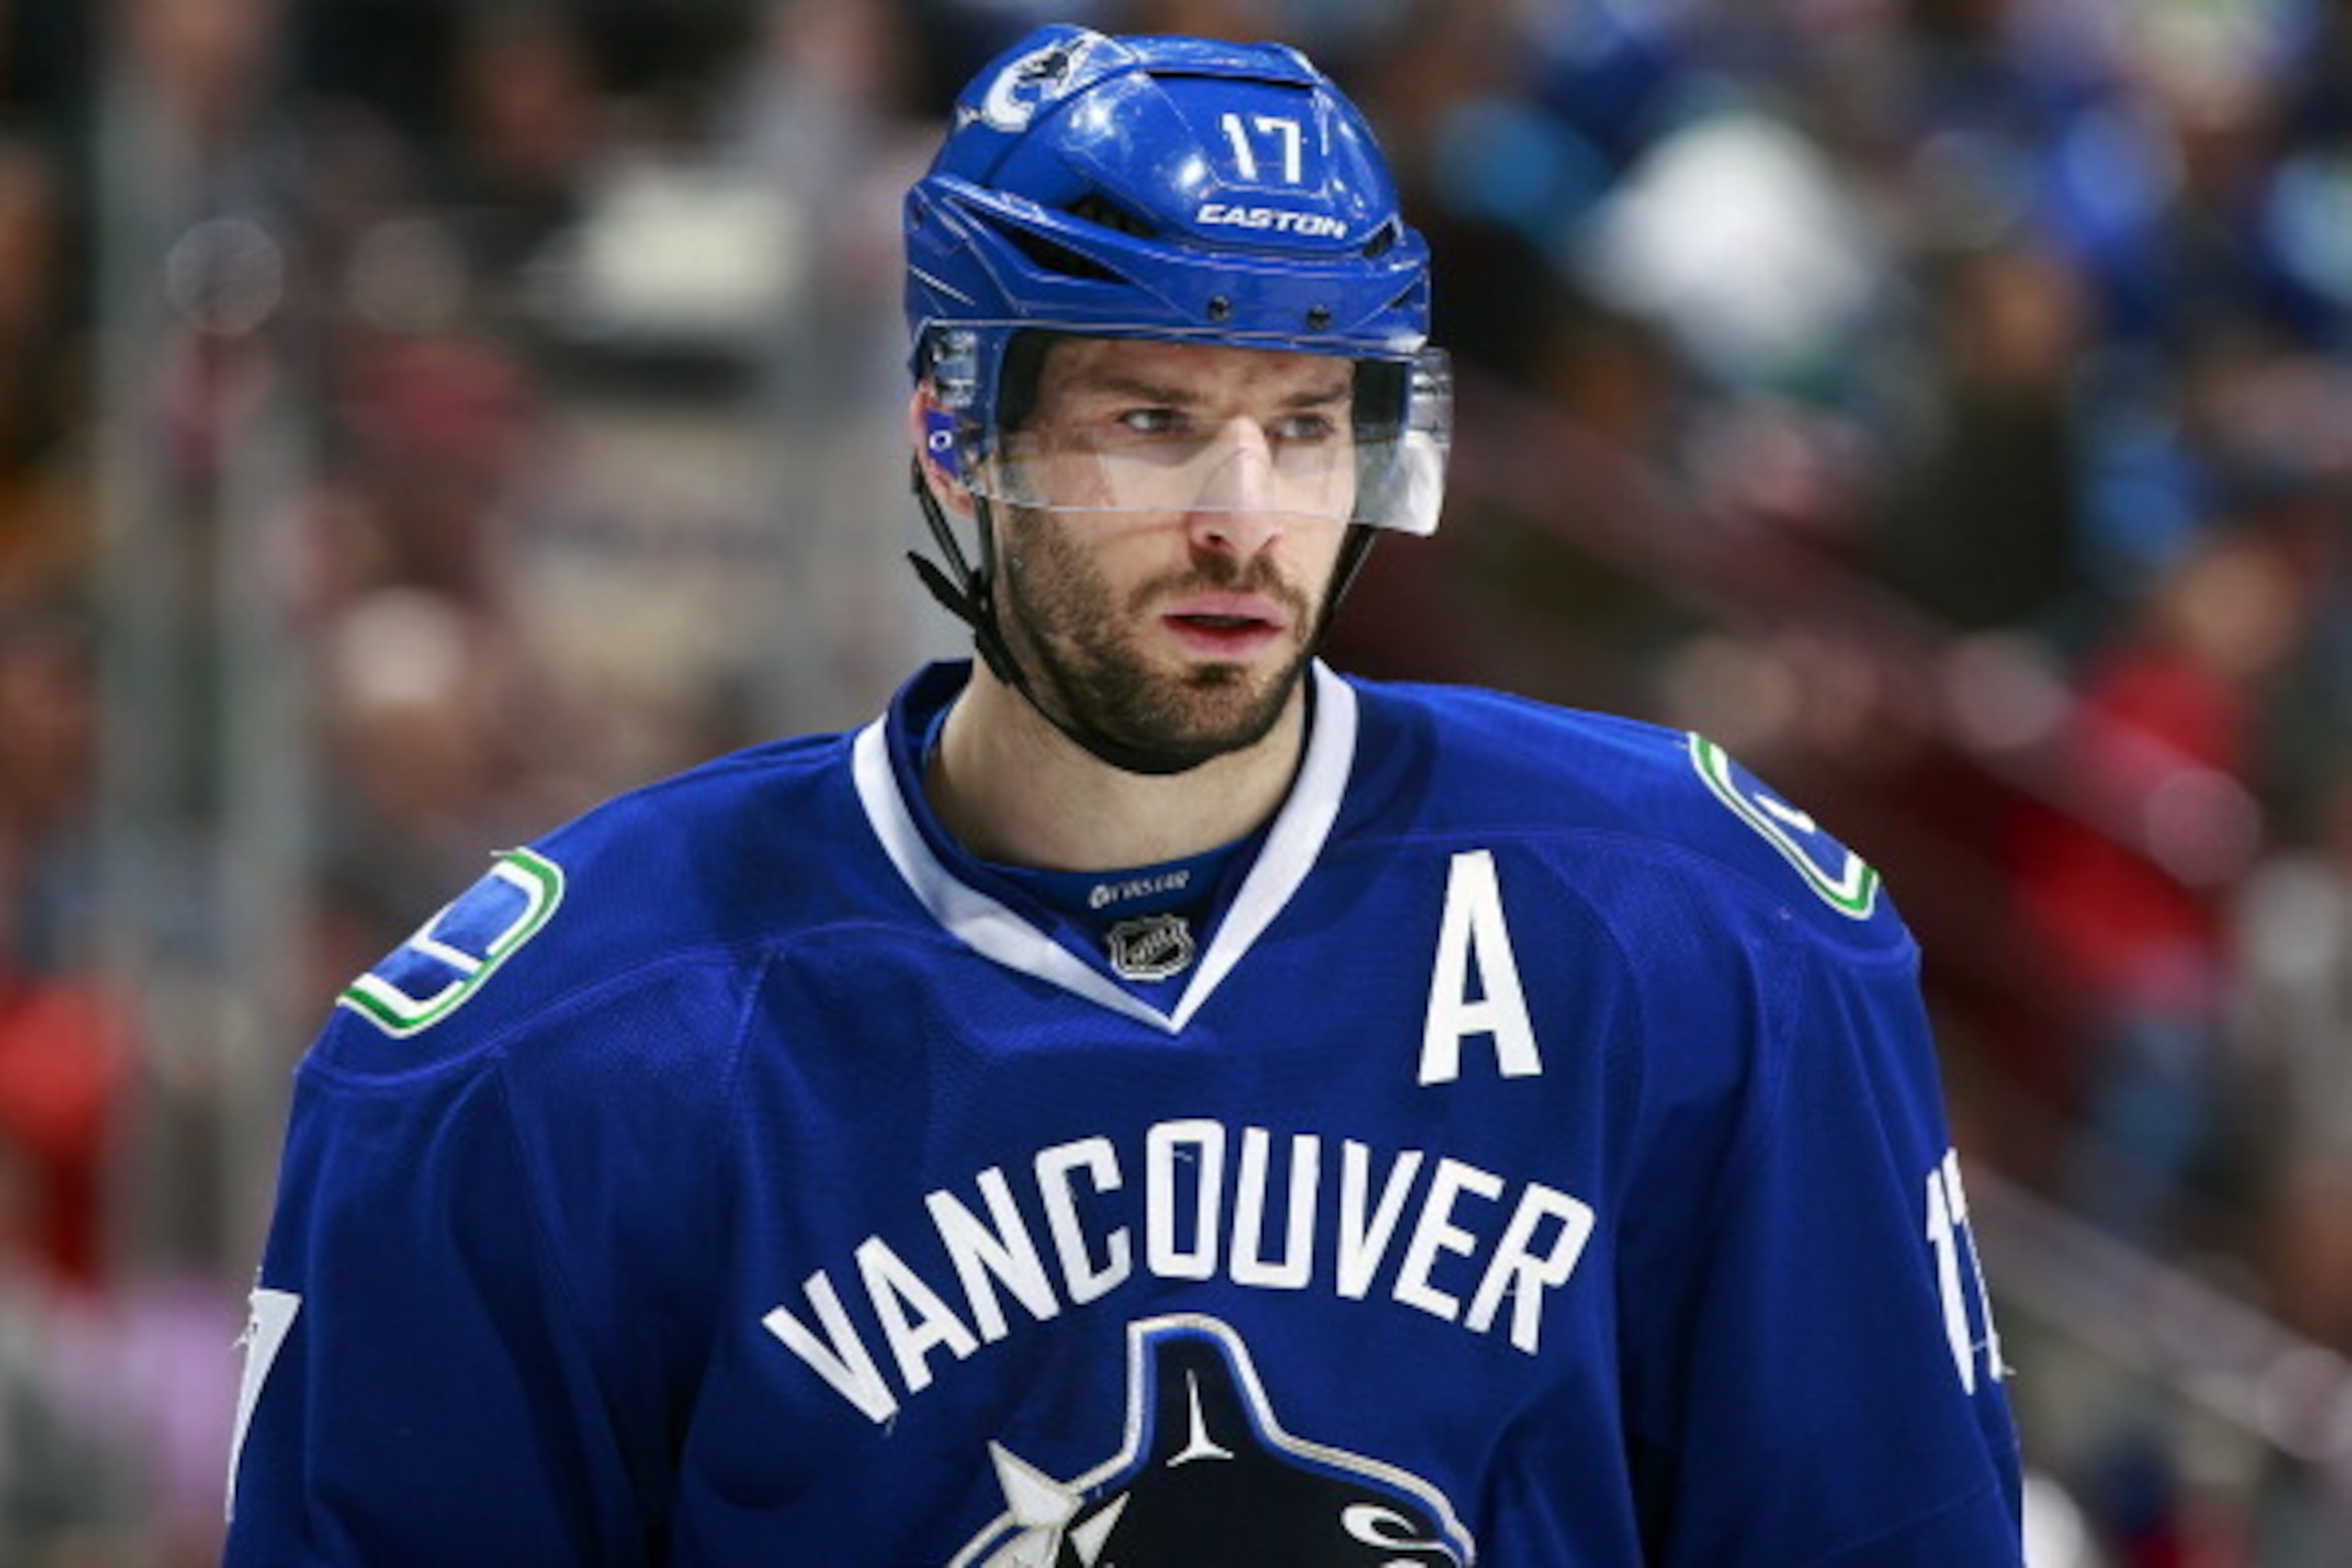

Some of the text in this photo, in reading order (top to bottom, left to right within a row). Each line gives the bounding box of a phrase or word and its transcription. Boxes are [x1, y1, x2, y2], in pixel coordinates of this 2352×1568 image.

[1196, 204, 1348, 240] EASTON
[1222, 113, 1300, 184] 17
[1419, 849, 1544, 1087] A
[762, 1118, 1596, 1424] VANCOUVER
